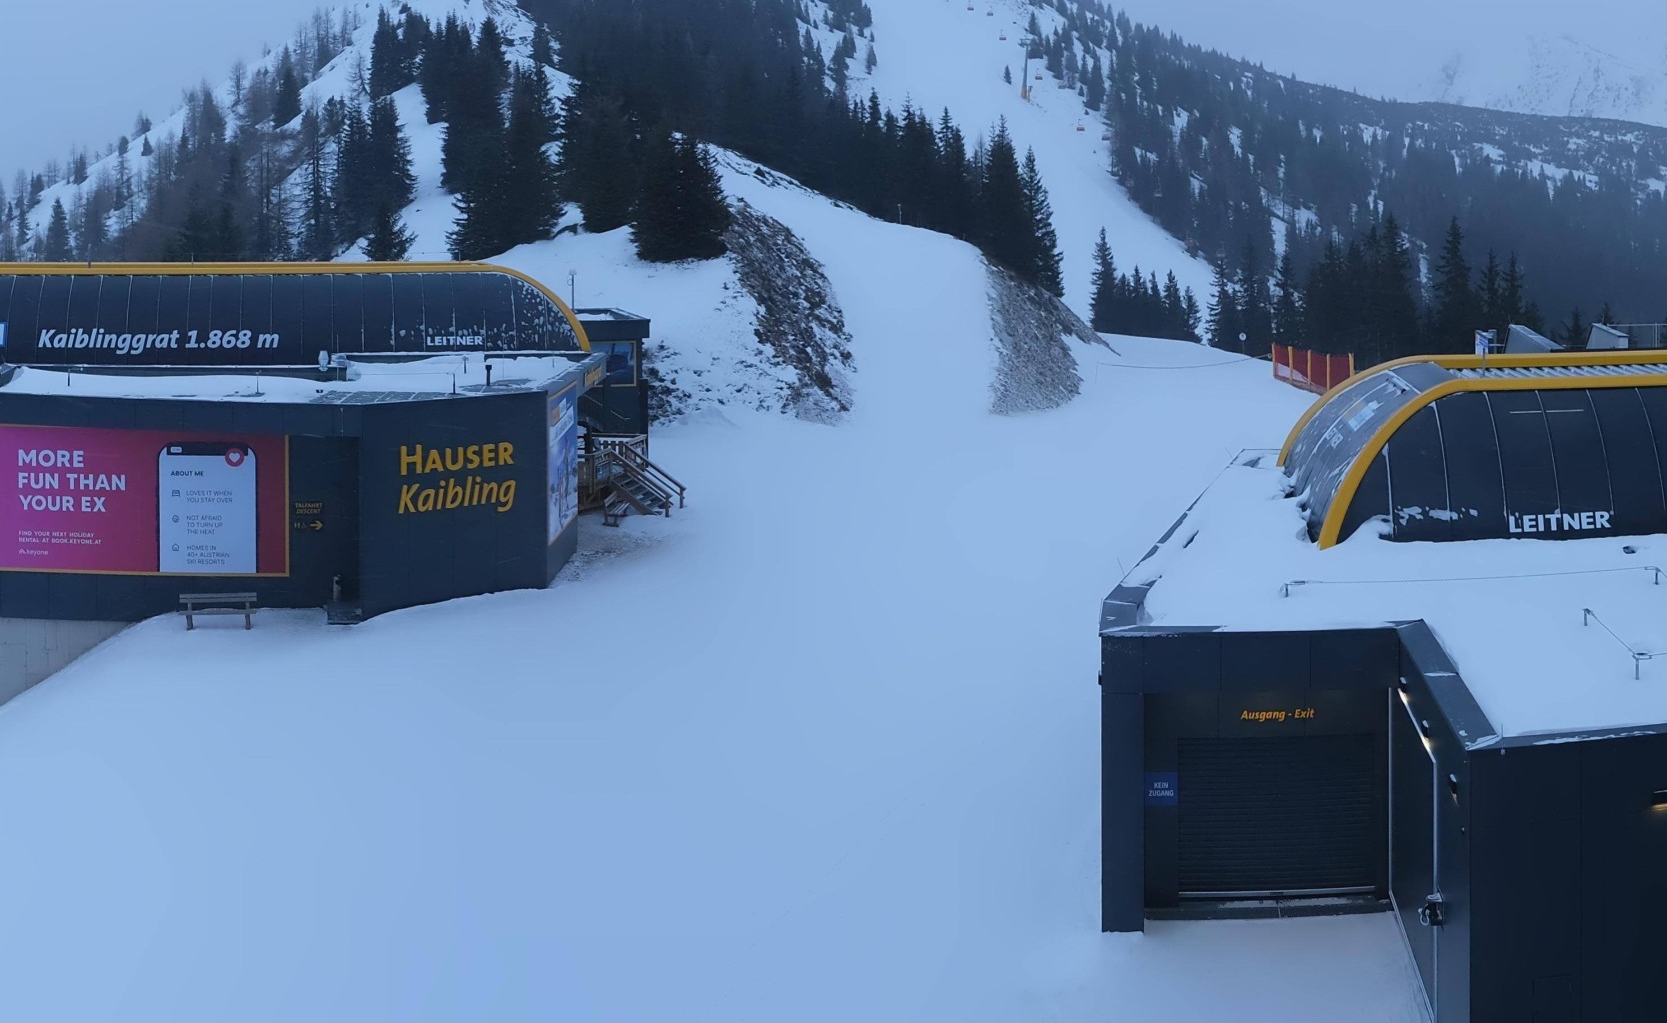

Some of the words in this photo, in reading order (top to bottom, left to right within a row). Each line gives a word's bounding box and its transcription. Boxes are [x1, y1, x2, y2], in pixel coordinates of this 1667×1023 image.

[38, 328, 180, 355] Kaiblinggrat
[185, 329, 252, 349] 1.868
[257, 333, 280, 349] m
[427, 336, 484, 346] LEITNER
[18, 449, 85, 468] MORE
[400, 442, 515, 475] HAUSER
[18, 472, 59, 490] FUN
[66, 474, 126, 491] THAN
[19, 495, 75, 512] YOUR
[81, 496, 106, 512] EX
[398, 476, 517, 514] Kaibling
[1509, 511, 1612, 534] LEITNER
[1240, 709, 1286, 722] Ausgang
[1294, 708, 1315, 719] Exit
[1148, 789, 1174, 797] ZUGANG
